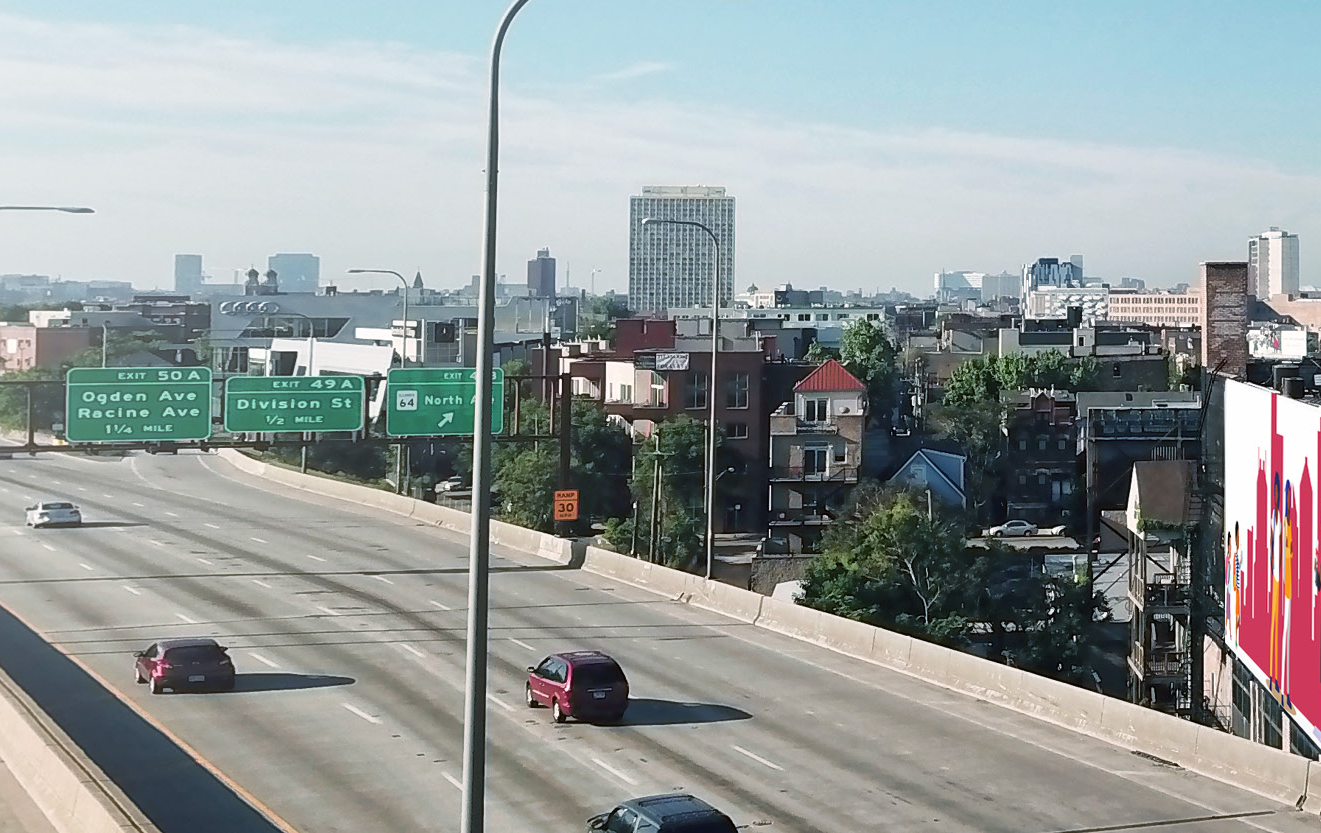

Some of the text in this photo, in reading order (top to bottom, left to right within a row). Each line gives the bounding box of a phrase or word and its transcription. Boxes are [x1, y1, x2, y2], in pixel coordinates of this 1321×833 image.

[118, 372, 147, 380] EXIT
[443, 372, 463, 380] EXIT
[82, 390, 197, 405] Ogden Ave
[424, 395, 463, 405] North
[237, 398, 352, 409] Division St
[399, 398, 414, 408] 64
[78, 407, 200, 419] Racine Ave
[294, 415, 324, 423] MILE
[143, 424, 174, 432] MILE
[558, 503, 574, 512] 30
